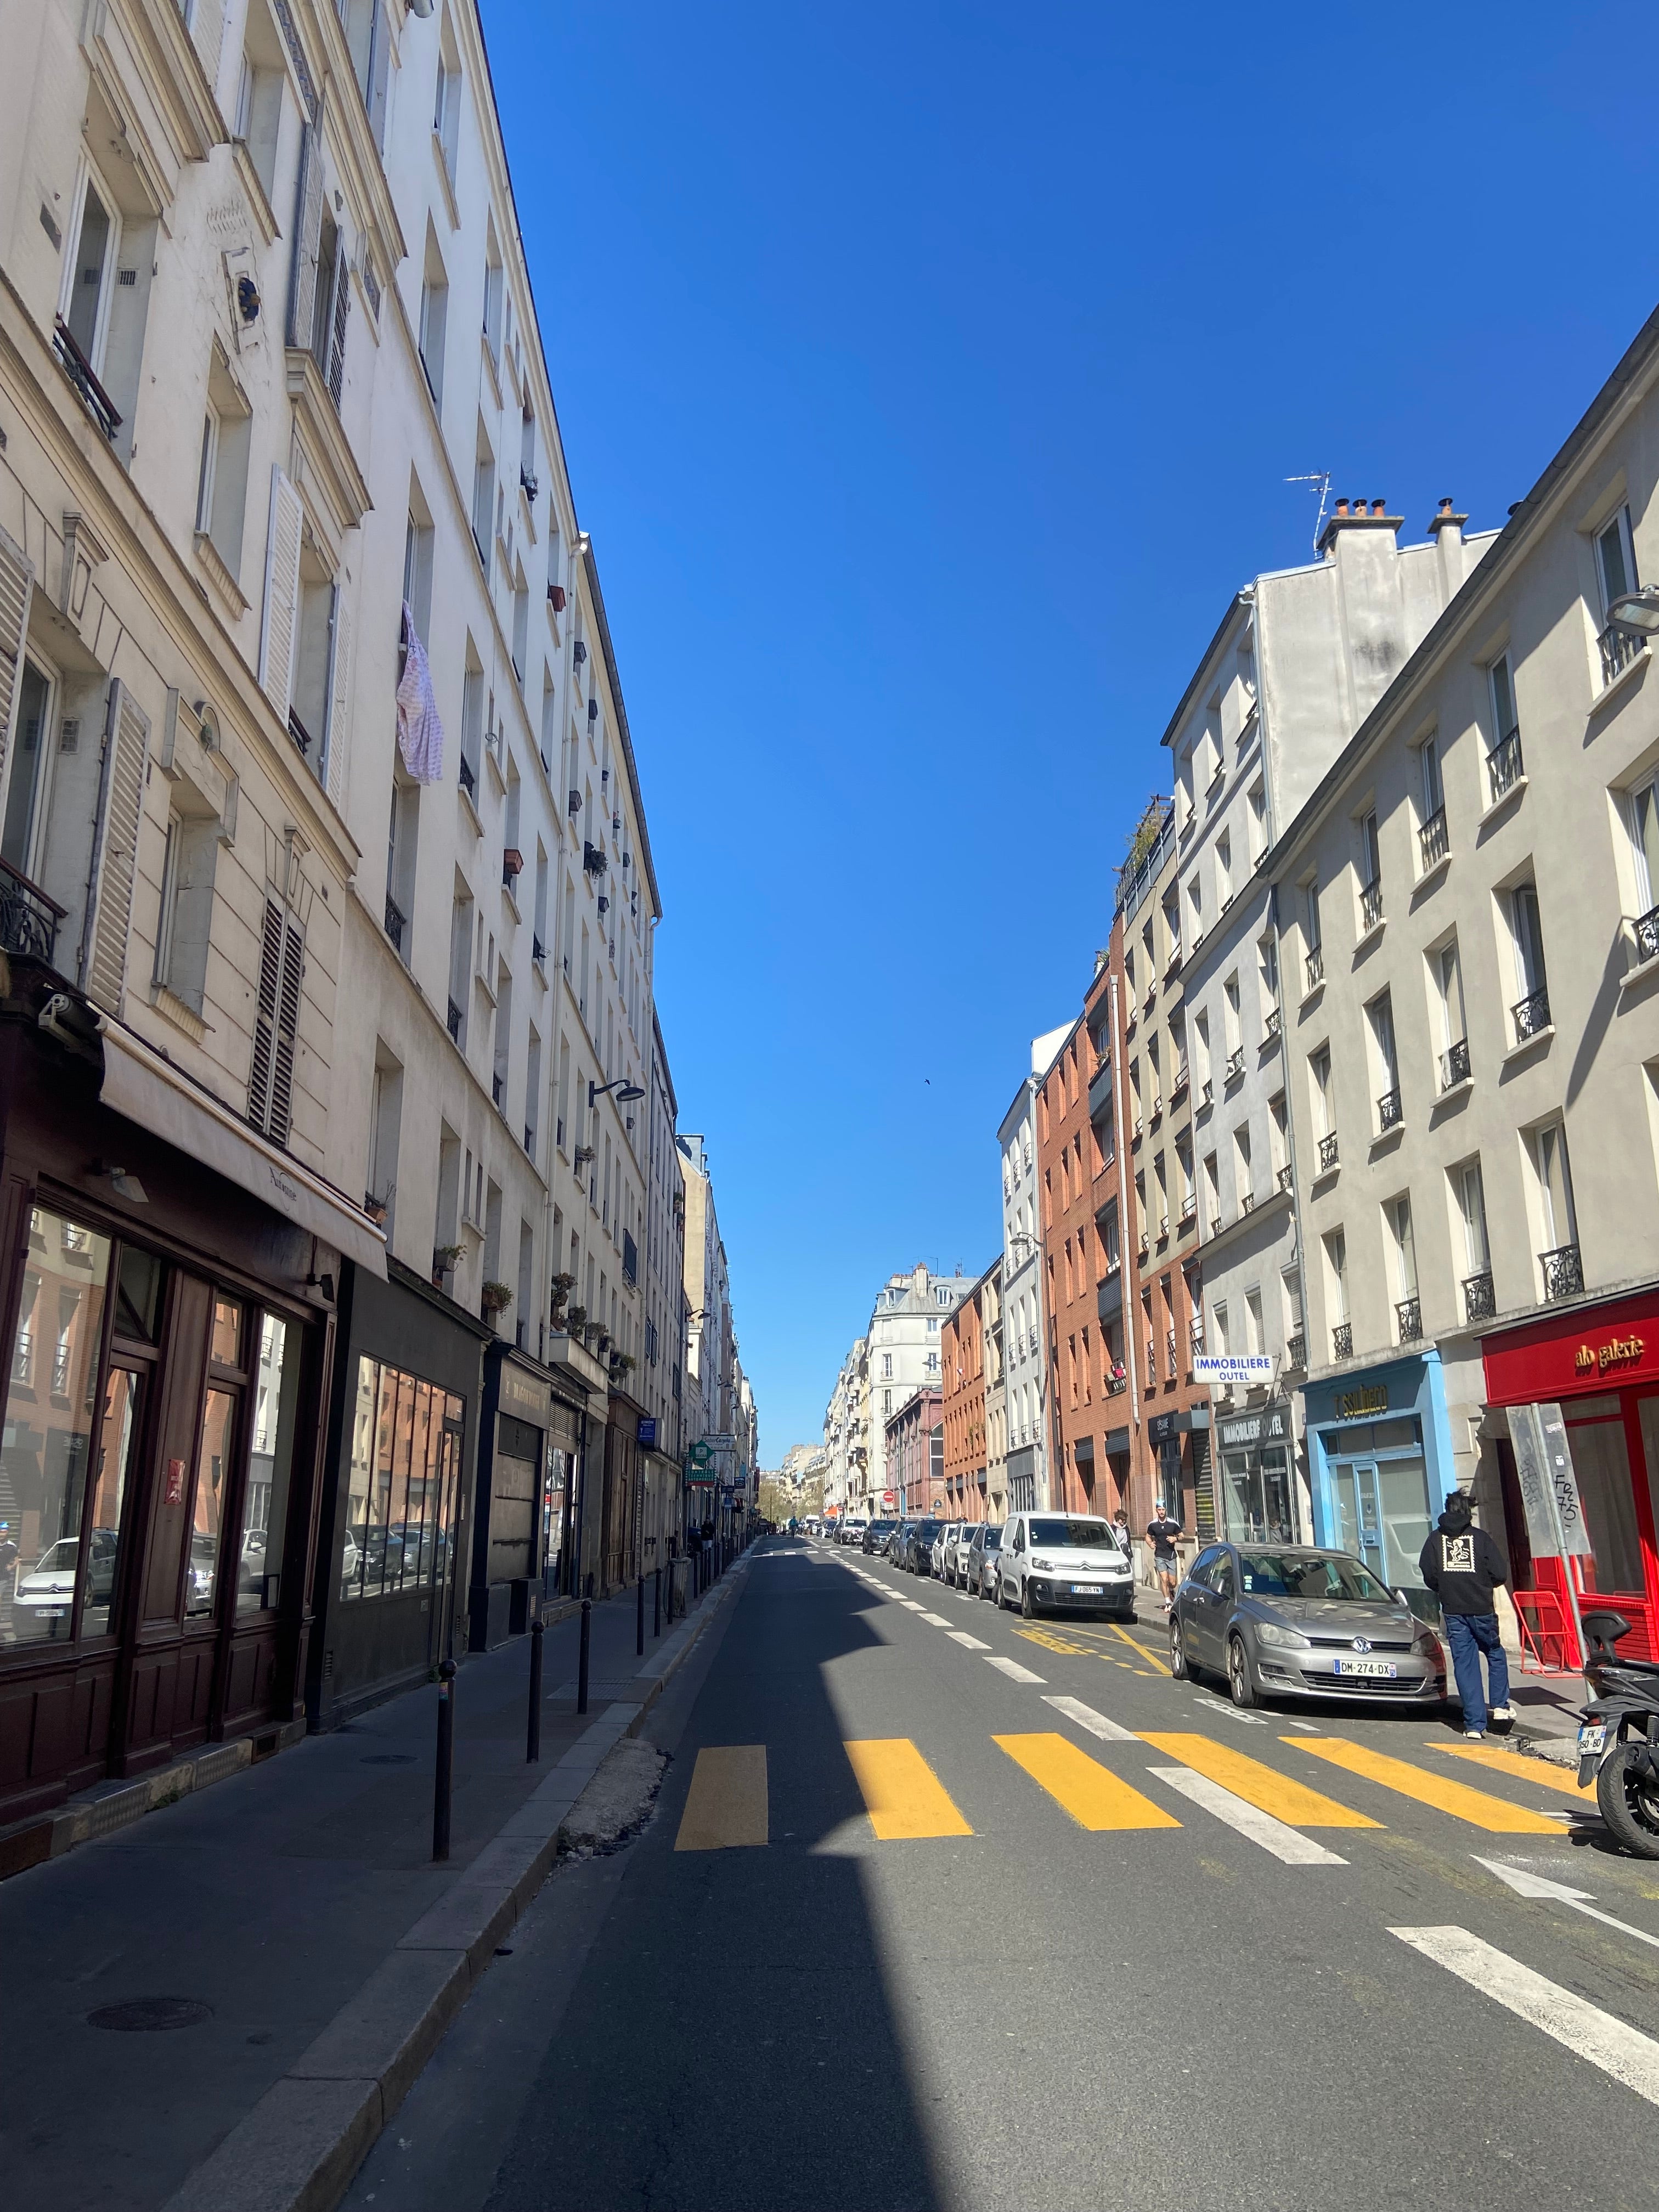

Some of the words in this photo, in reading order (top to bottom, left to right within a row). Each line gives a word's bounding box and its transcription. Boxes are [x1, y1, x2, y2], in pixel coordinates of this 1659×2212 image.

[1599, 1335, 1644, 1368] galerie
[1196, 1358, 1270, 1369] IMMOBILIERE
[1219, 1372, 1250, 1380] OUTEL
[1223, 1419, 1260, 1444] IMMOBILIERE
[1341, 1662, 1389, 1675] DM-274-DX
